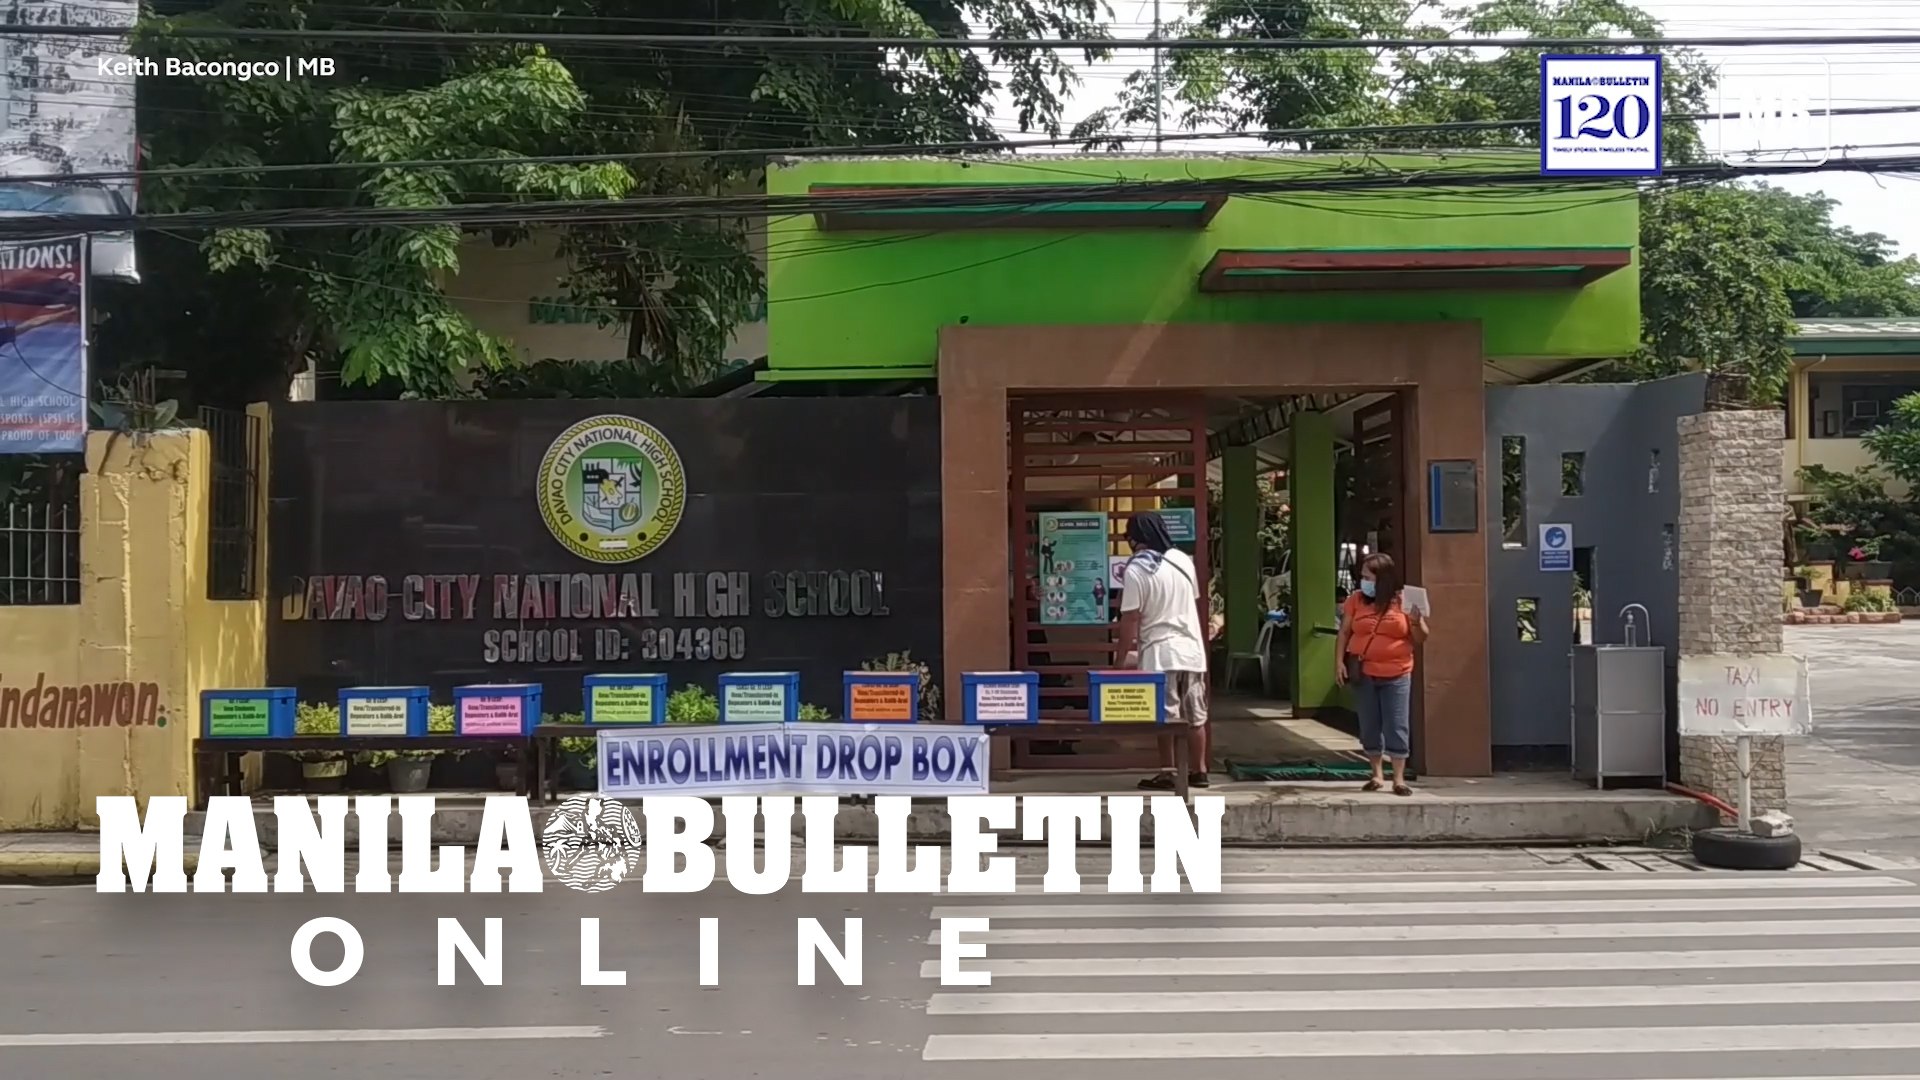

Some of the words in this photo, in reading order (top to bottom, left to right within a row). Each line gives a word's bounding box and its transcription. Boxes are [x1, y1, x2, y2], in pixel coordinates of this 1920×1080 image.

[10, 395, 34, 407] HIGH
[39, 395, 77, 407] SCHOOL
[2, 430, 33, 441] PROUD
[38, 430, 50, 441] OF
[573, 428, 639, 452] NATIONAL
[554, 446, 576, 476] CITY
[639, 438, 669, 471] HIGH
[551, 479, 574, 526] DAVAO
[650, 470, 674, 524] SCHOOL
[402, 574, 481, 620] CITY
[493, 573, 660, 619] NATIONAL
[763, 569, 890, 617] SCHOOL
[483, 628, 583, 663] SCHOOL
[595, 627, 630, 661] ID:
[641, 626, 746, 662] 304360
[1724, 666, 1761, 687] TAXI
[0, 672, 167, 728] ndanawon.
[1696, 698, 1720, 716] NO
[1733, 698, 1793, 718] ENTRY
[606, 734, 808, 786] ENROLLMENT
[816, 735, 901, 782] DROP
[912, 736, 980, 782] BOX
